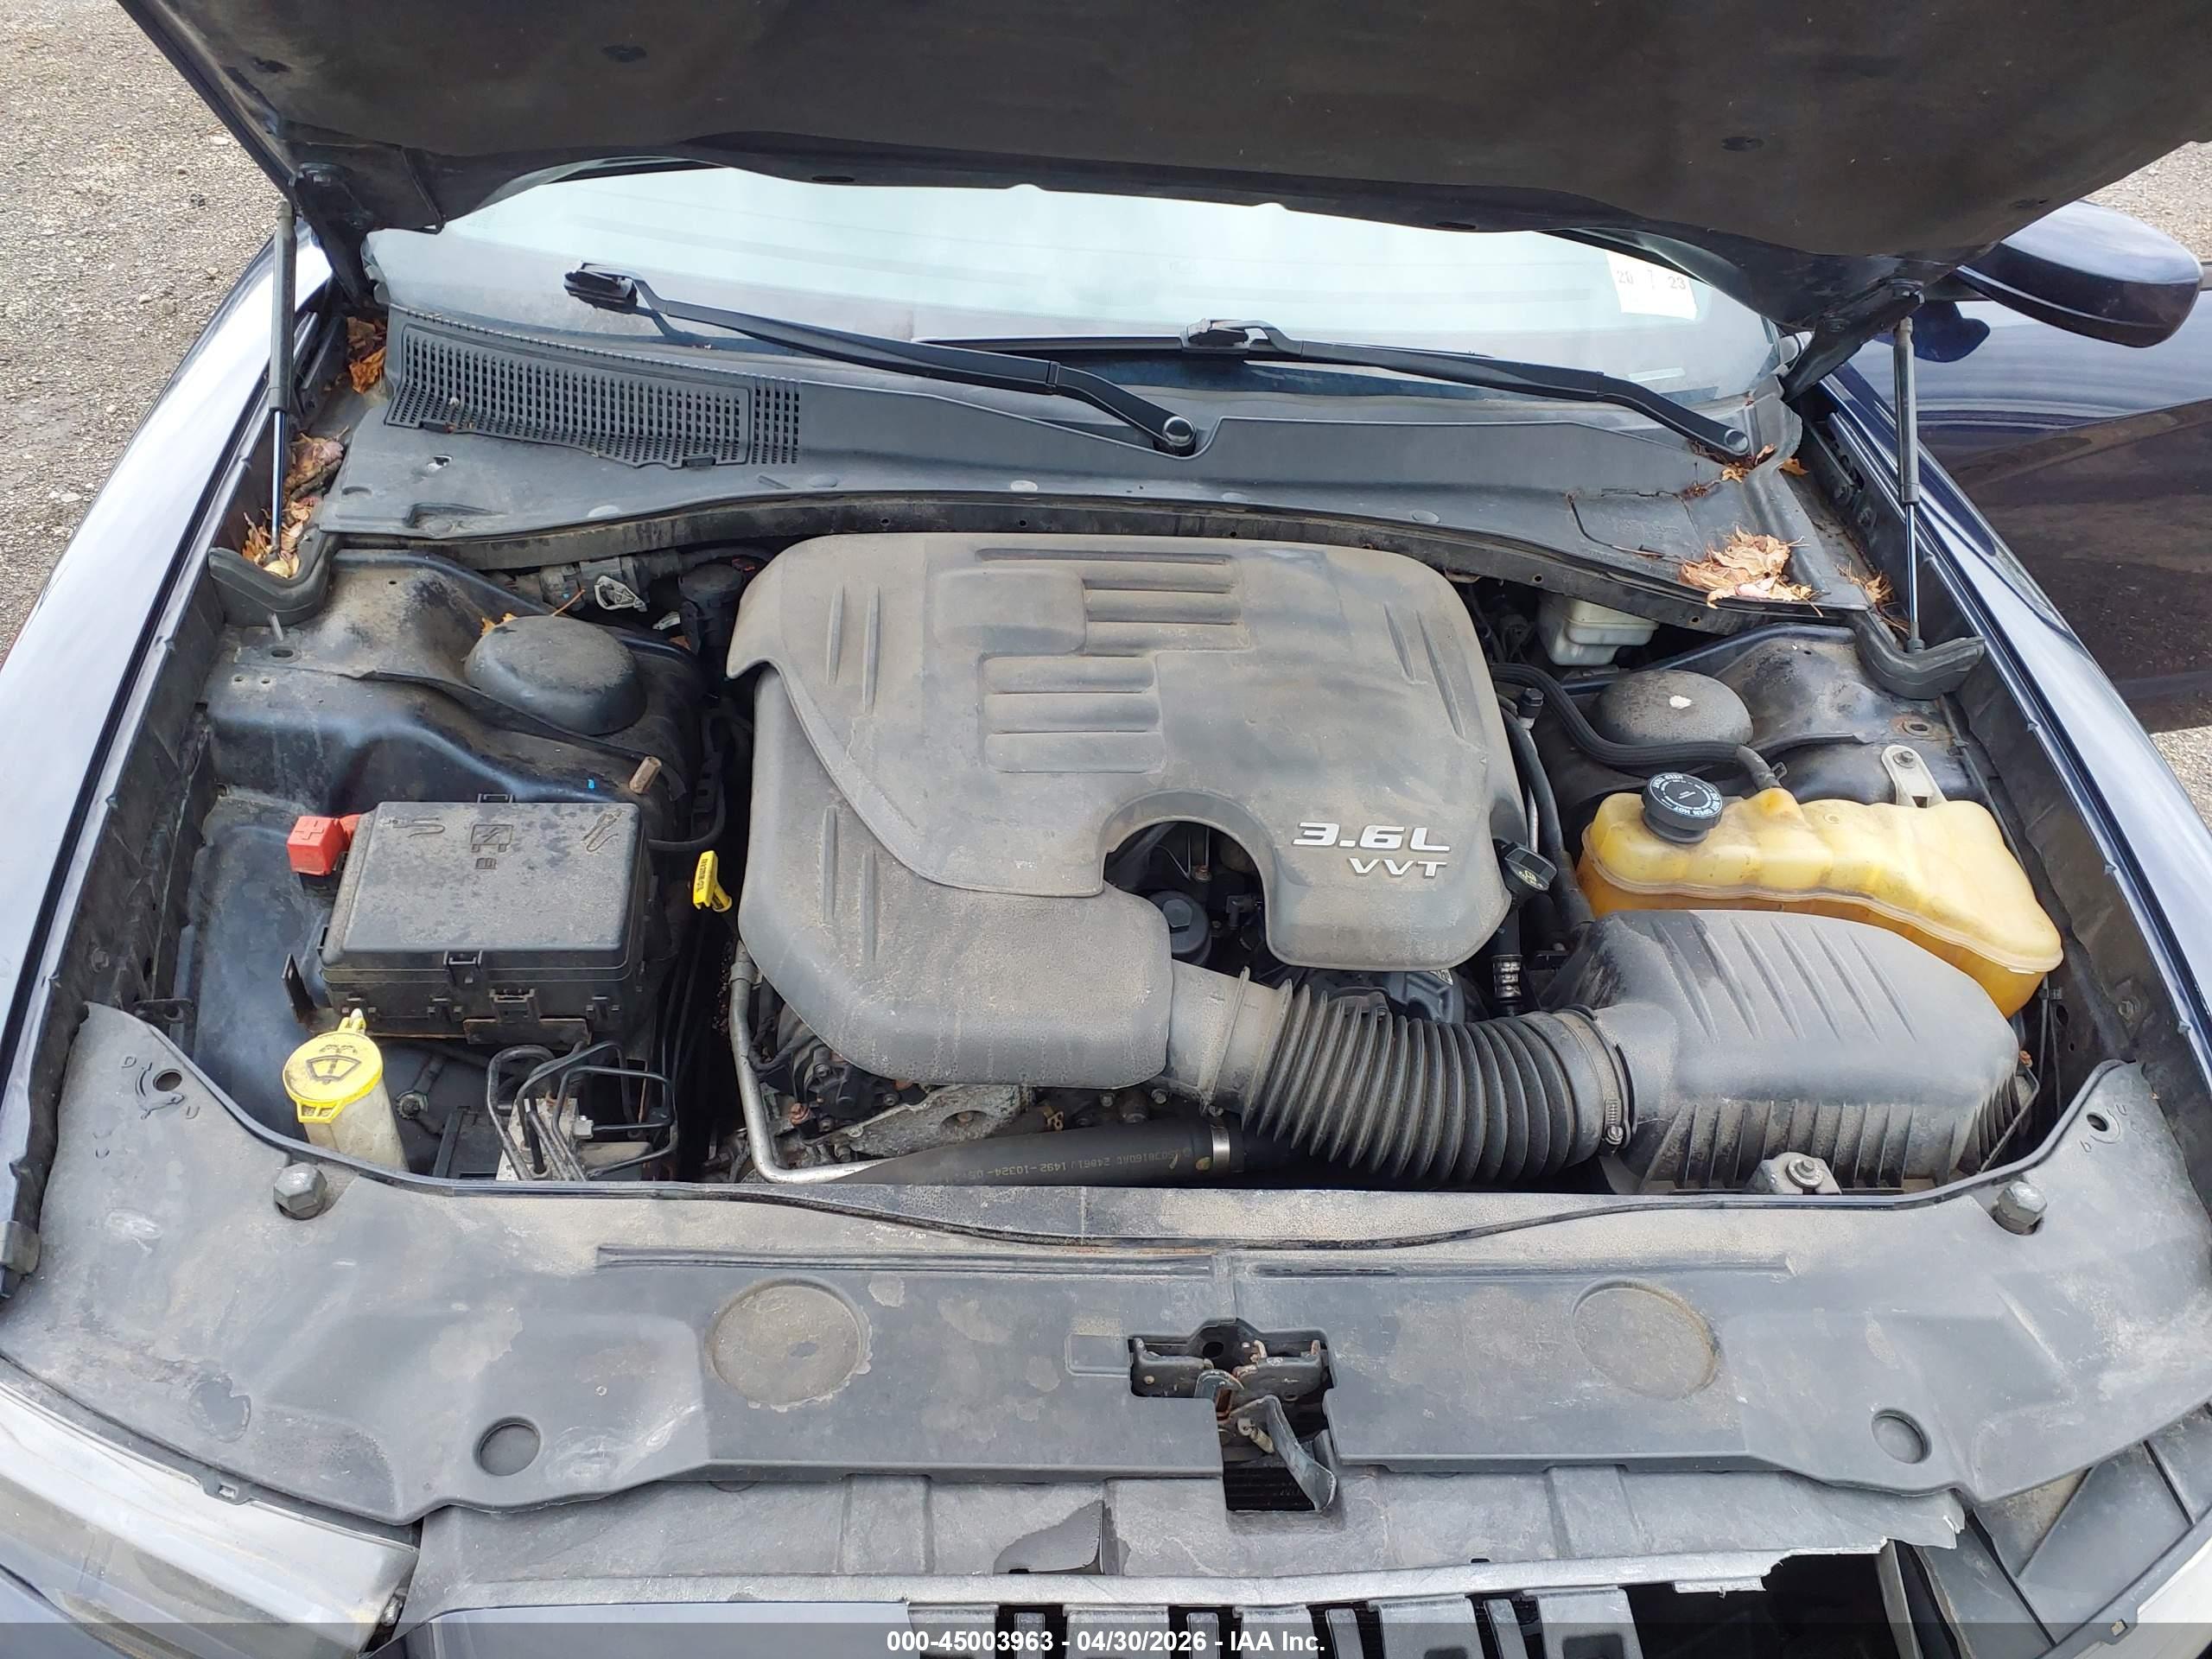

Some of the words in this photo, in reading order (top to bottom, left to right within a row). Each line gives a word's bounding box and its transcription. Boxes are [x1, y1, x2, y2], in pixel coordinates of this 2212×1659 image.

[1667, 276, 1687, 290] 23
[1673, 806, 1691, 815] HOT
[1692, 808, 1714, 817] OPEN
[1292, 822, 1451, 852] 3.6L
[1348, 857, 1448, 877] VVT
